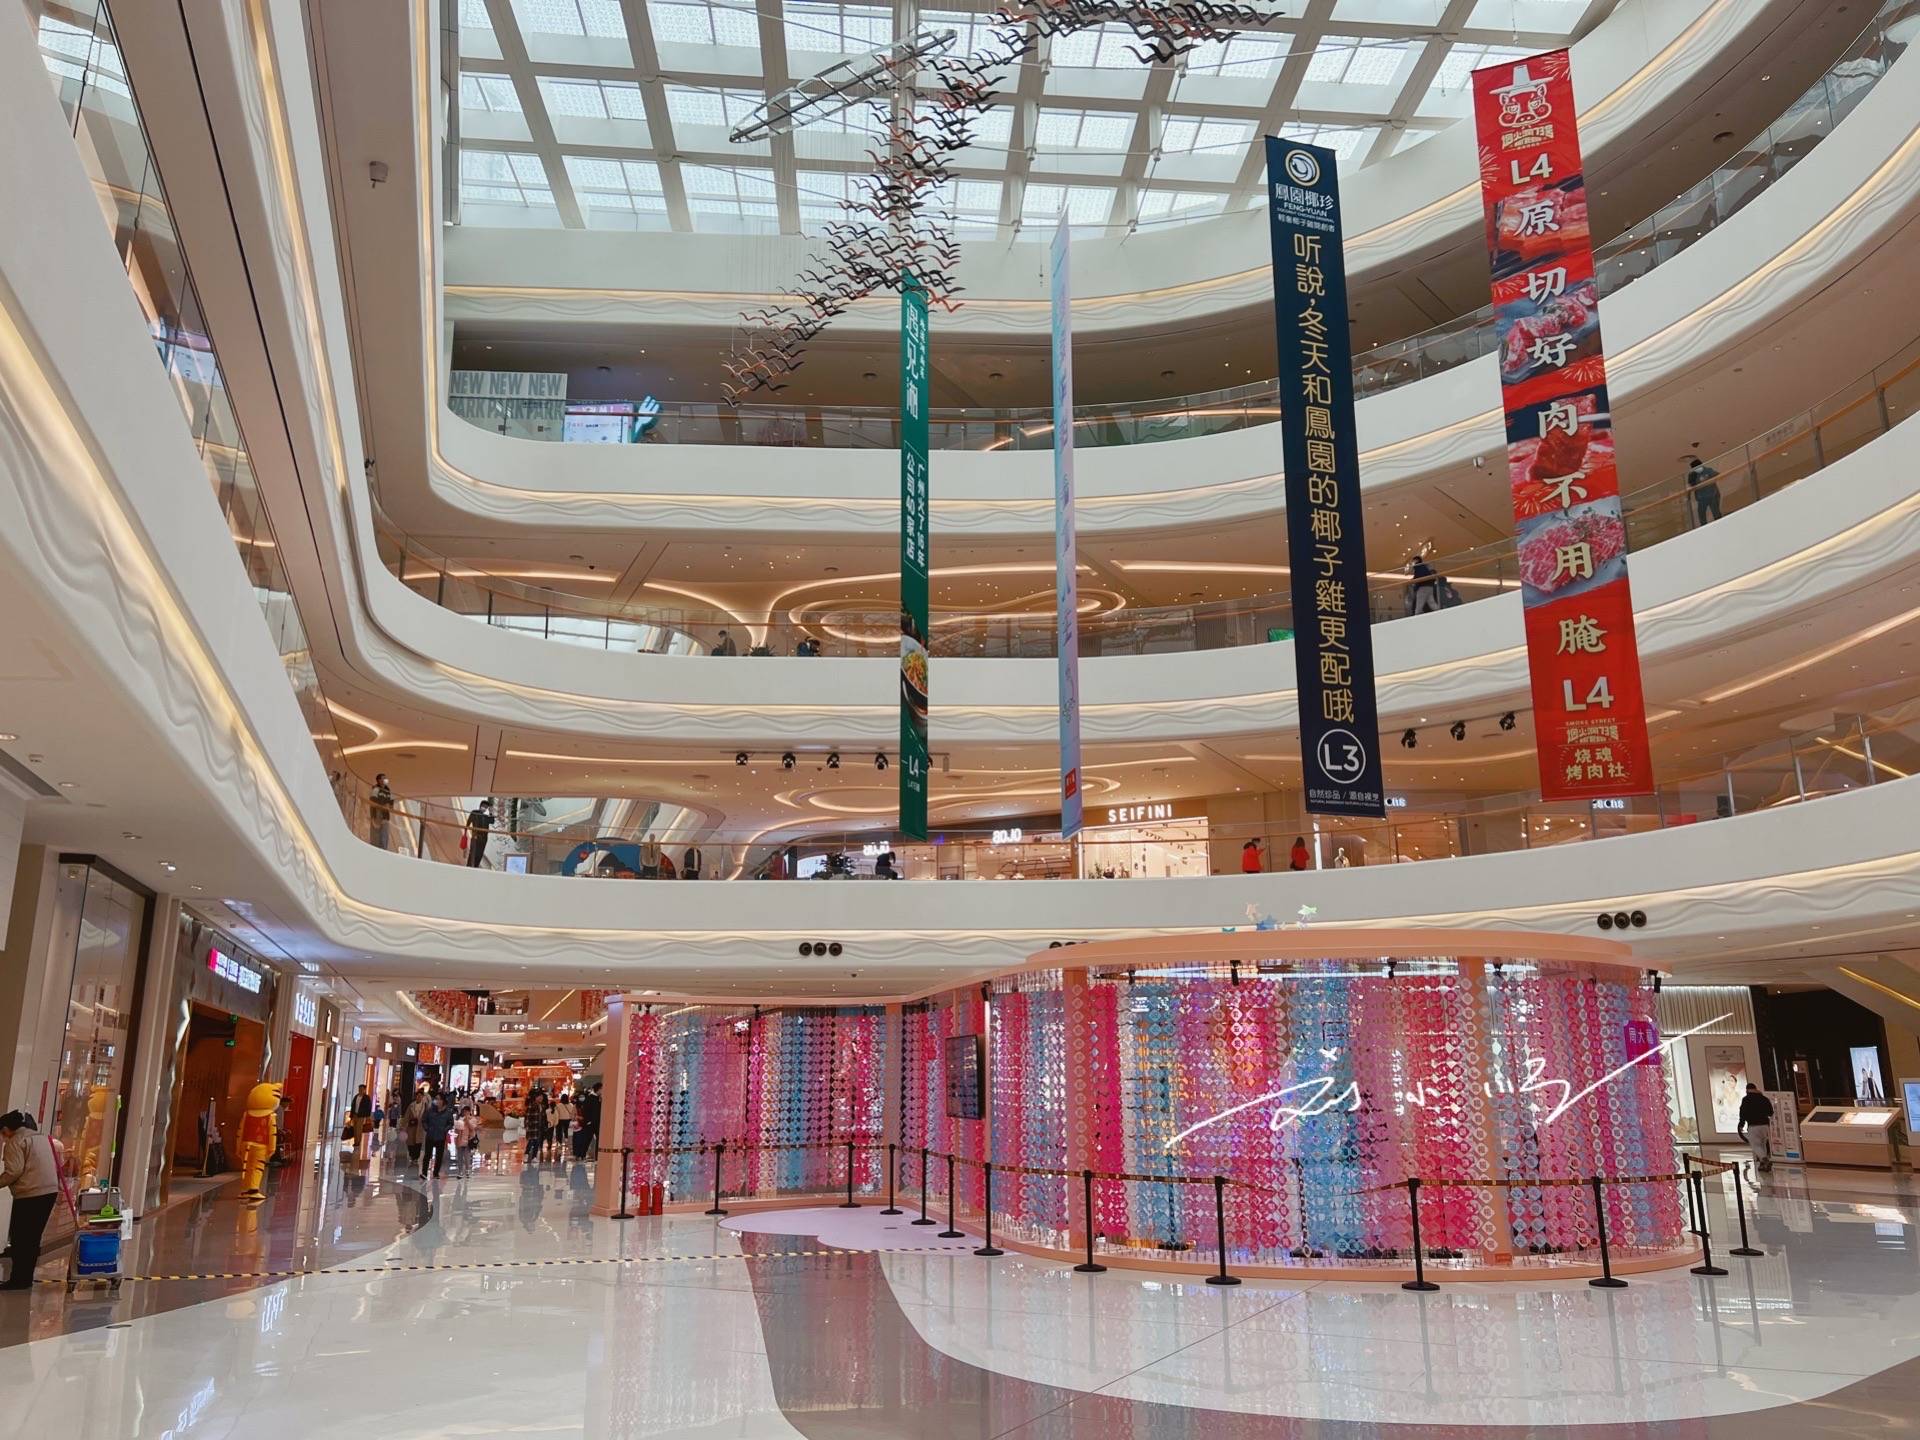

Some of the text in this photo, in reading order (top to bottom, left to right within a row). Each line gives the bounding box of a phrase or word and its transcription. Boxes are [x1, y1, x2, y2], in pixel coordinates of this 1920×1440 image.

[1511, 152, 1554, 185] L4
[1284, 202, 1328, 217] FENG-YUAN
[450, 372, 562, 396] NEW NEW NEW
[449, 398, 485, 419] PARK
[1513, 200, 1608, 657] 原切好肉不用腌
[1563, 676, 1614, 712] L4
[1324, 742, 1360, 772] L3
[1574, 745, 1613, 764] 烧魂
[909, 755, 920, 778] L4
[1566, 761, 1625, 782] 烤肉社
[1108, 803, 1173, 823] SEIFINI
